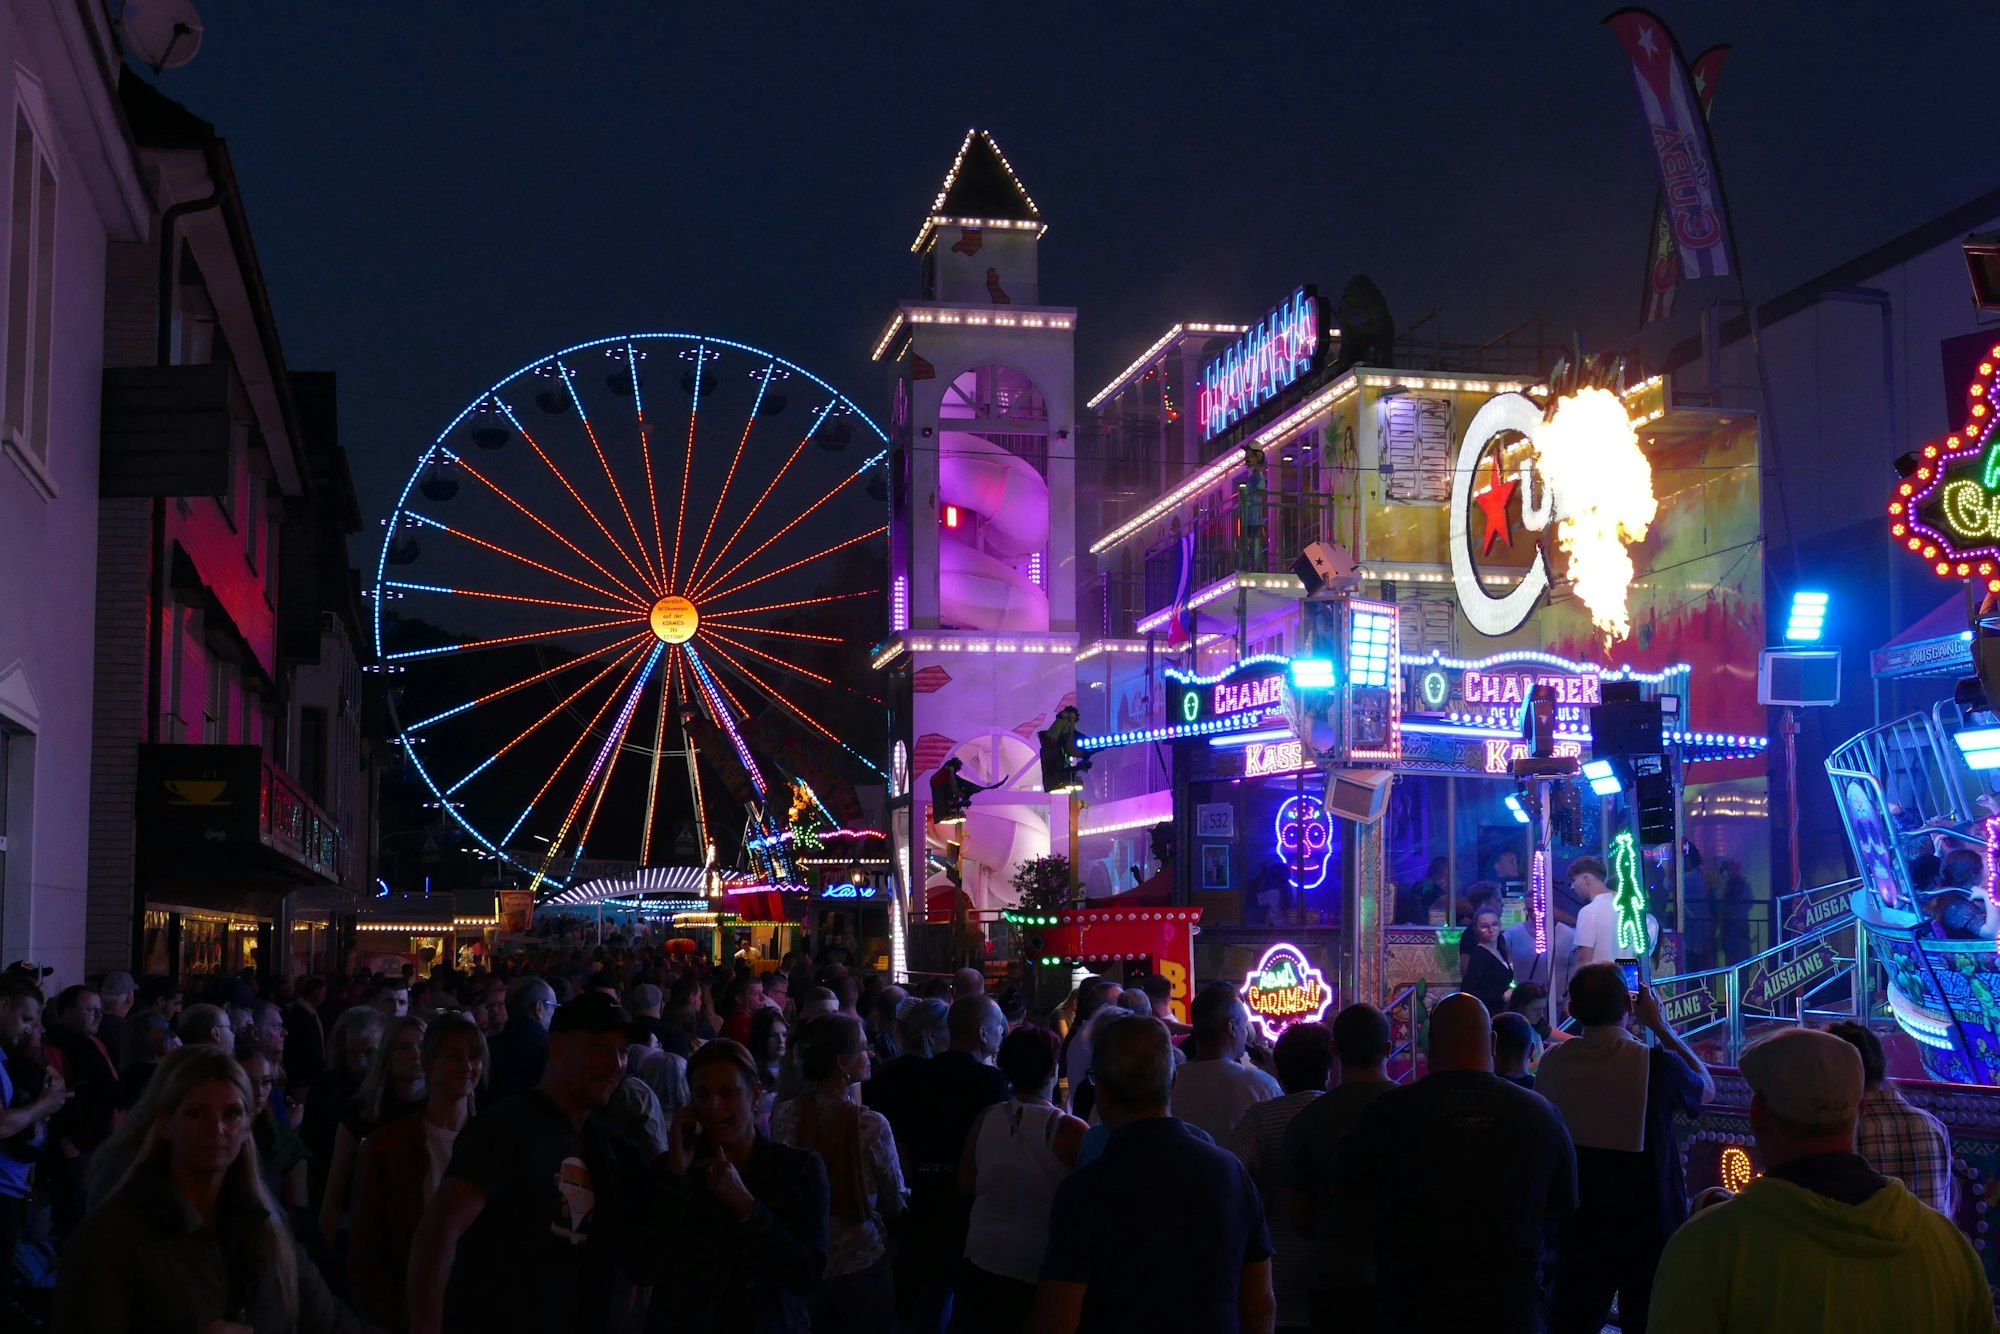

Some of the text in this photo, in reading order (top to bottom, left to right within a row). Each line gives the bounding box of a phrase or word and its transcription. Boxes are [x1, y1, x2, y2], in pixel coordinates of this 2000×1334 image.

[1203, 289, 1313, 440] HAVANA
[1911, 640, 1963, 664] AUSGANG
[1214, 675, 1281, 714] CHAMB
[1555, 706, 1581, 721] ULS
[1245, 741, 1303, 778] KASS
[1209, 812, 1228, 829] 532
[1805, 893, 1854, 928] AUSGA
[1763, 952, 1824, 1001] AUSGANG
[1248, 978, 1321, 1016] CARAMBA!
[1665, 995, 1701, 1022] GANG
